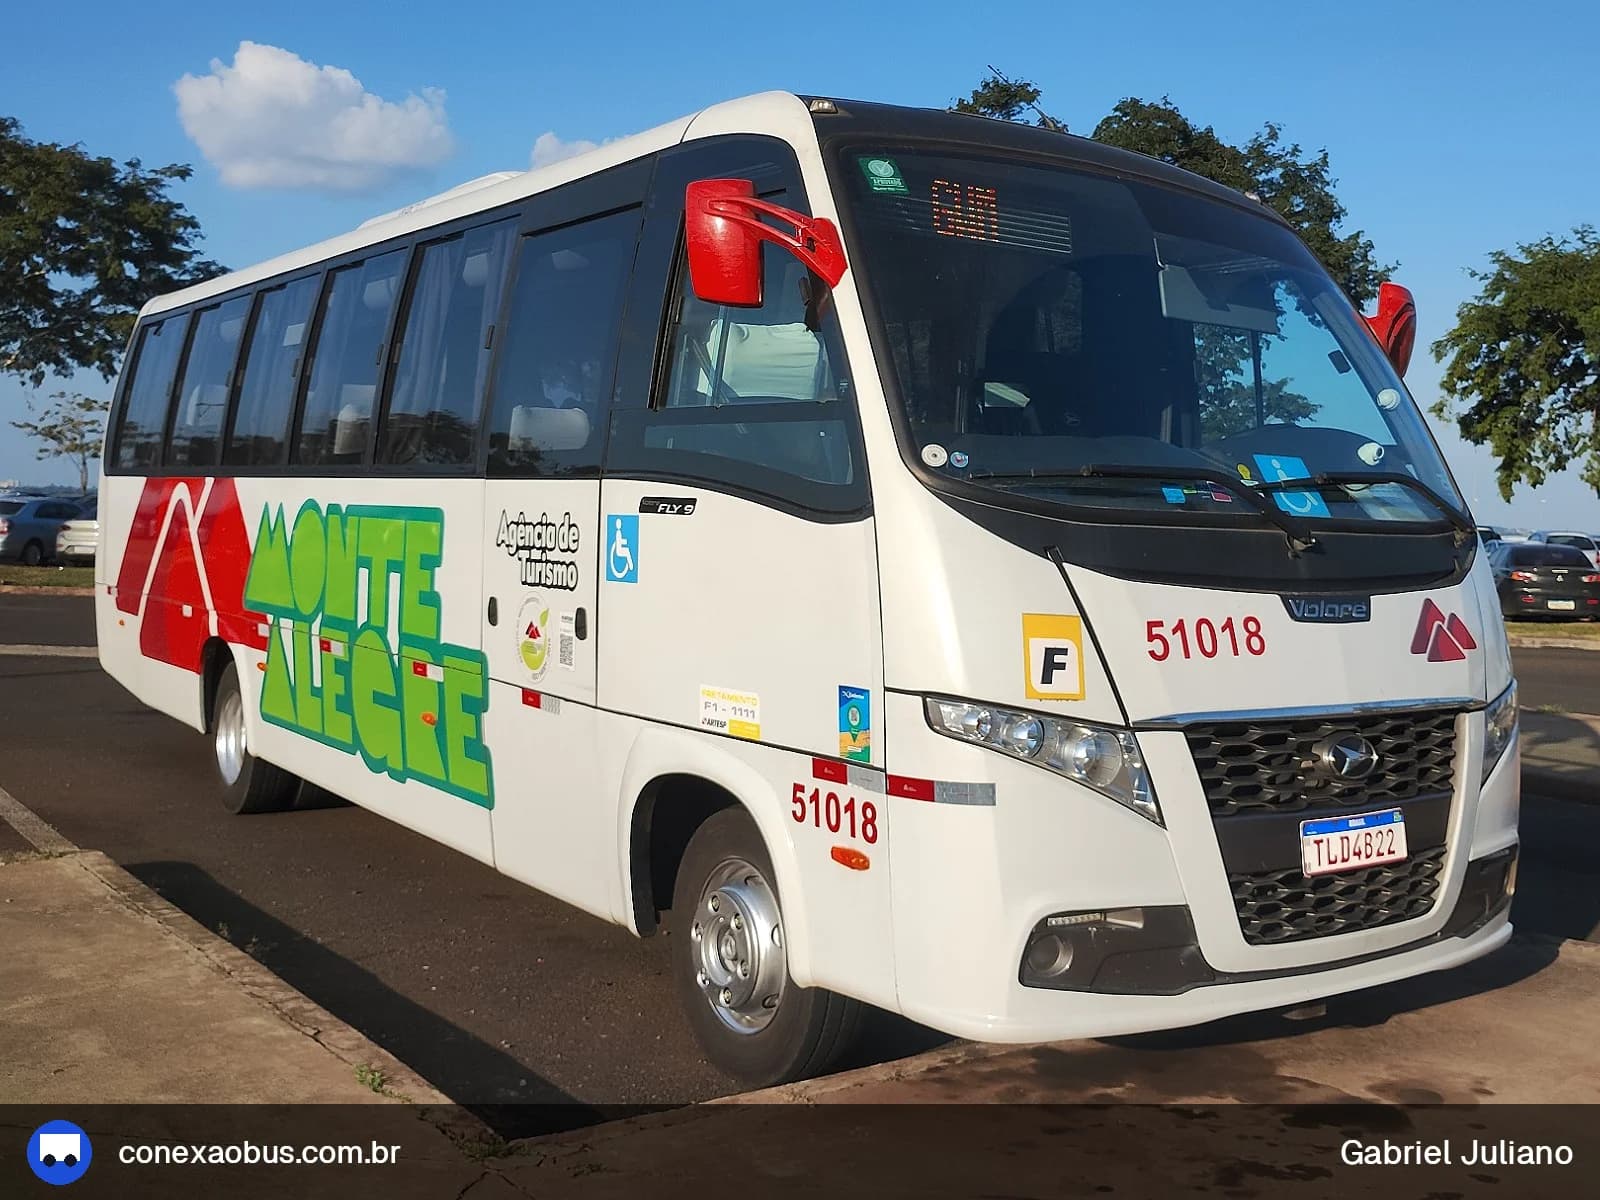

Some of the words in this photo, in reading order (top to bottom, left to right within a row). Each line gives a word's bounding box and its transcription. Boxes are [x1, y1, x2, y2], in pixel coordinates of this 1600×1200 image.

[657, 503, 682, 514] FLY
[684, 504, 694, 515] 9
[496, 508, 557, 556] Agência
[558, 511, 580, 553] de
[246, 499, 443, 641] MONTE
[518, 550, 579, 591] Turismo
[1288, 598, 1367, 618] Volare
[1146, 615, 1267, 662] 51018
[1039, 646, 1069, 685] F
[262, 615, 492, 806] ALEGRE
[704, 701, 718, 712] F1
[731, 706, 756, 720] 1111
[706, 717, 727, 728] ARTESP
[791, 782, 879, 844] 51018
[1312, 827, 1396, 867] TLD4B22
